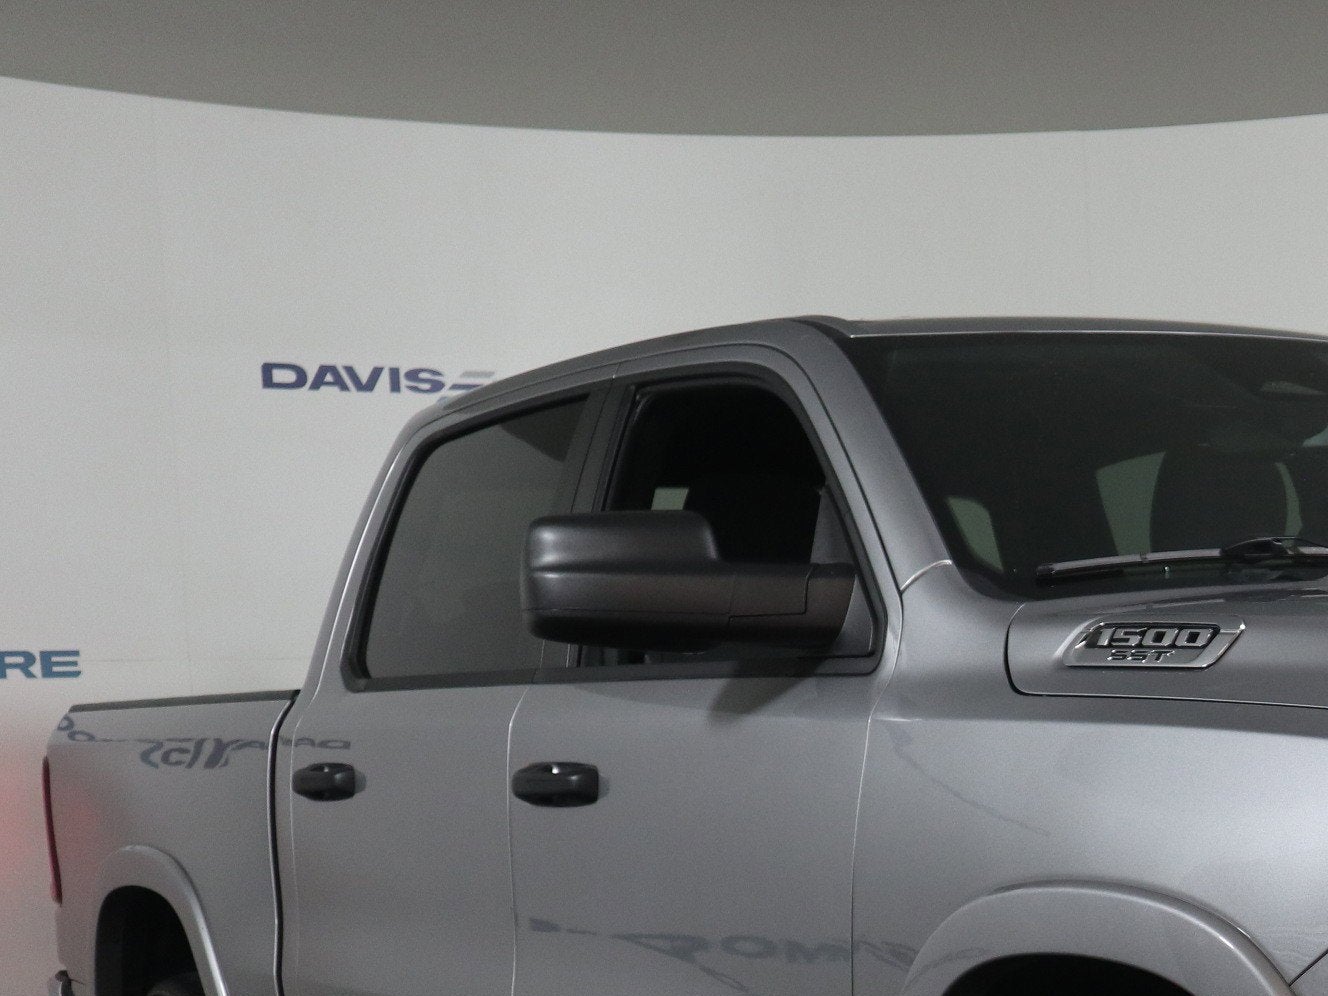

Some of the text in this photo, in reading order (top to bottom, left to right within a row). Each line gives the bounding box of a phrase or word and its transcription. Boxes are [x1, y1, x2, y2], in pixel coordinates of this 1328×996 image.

[261, 362, 446, 394] DAVIS
[1097, 627, 1217, 648] 1500
[1106, 649, 1176, 664] SST
